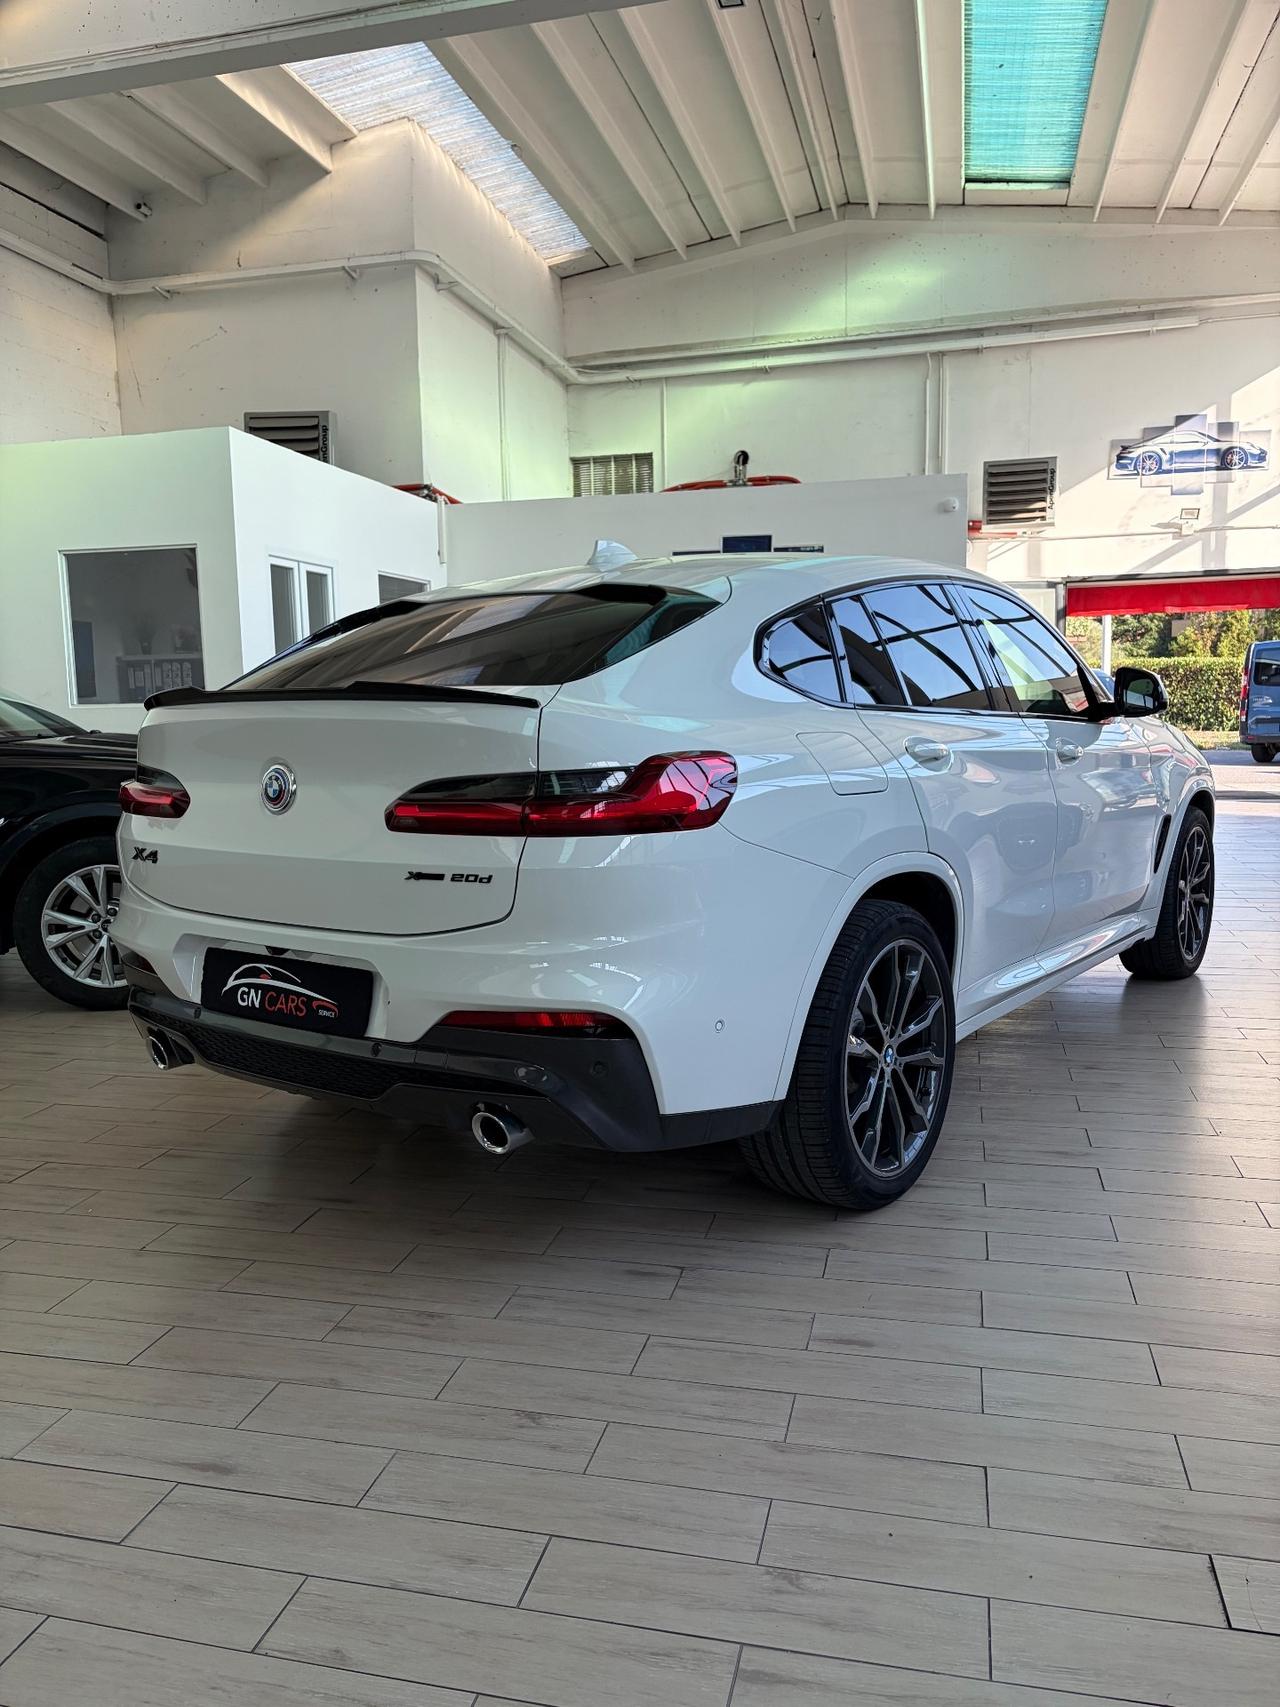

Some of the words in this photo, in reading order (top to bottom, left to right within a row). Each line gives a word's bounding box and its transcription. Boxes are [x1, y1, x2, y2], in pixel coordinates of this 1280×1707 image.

[131, 846, 159, 864] X4
[450, 873, 493, 884] 20d
[237, 986, 262, 1009] GN
[264, 991, 307, 1017] CARS
